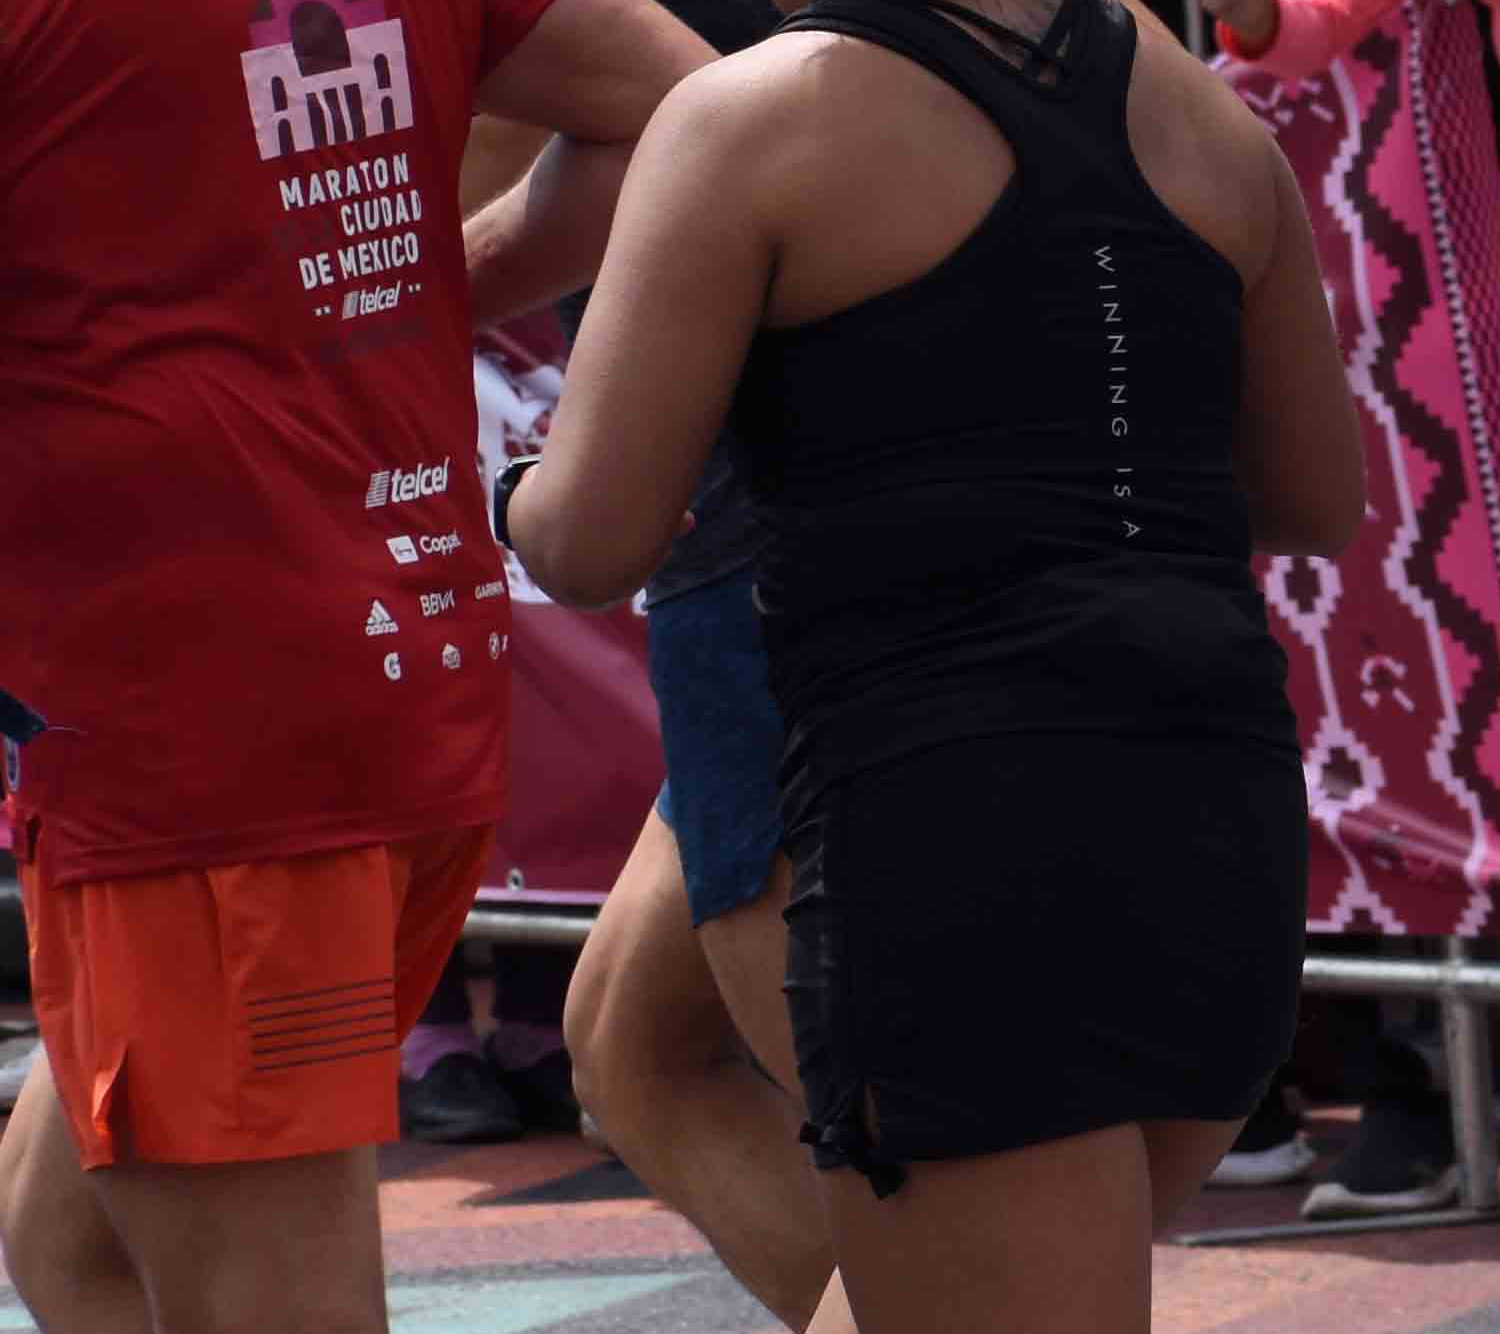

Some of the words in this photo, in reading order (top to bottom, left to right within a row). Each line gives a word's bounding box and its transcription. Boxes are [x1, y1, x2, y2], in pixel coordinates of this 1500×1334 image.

[278, 152, 410, 212] MARATON
[340, 188, 422, 236] CIUDAD
[298, 251, 334, 291] DE
[336, 231, 420, 280] MEXICO
[359, 279, 402, 315] telcel
[1094, 245, 1128, 437] WINNING
[391, 456, 451, 503] telcel
[1113, 467, 1133, 498] IS
[1122, 519, 1143, 538] A
